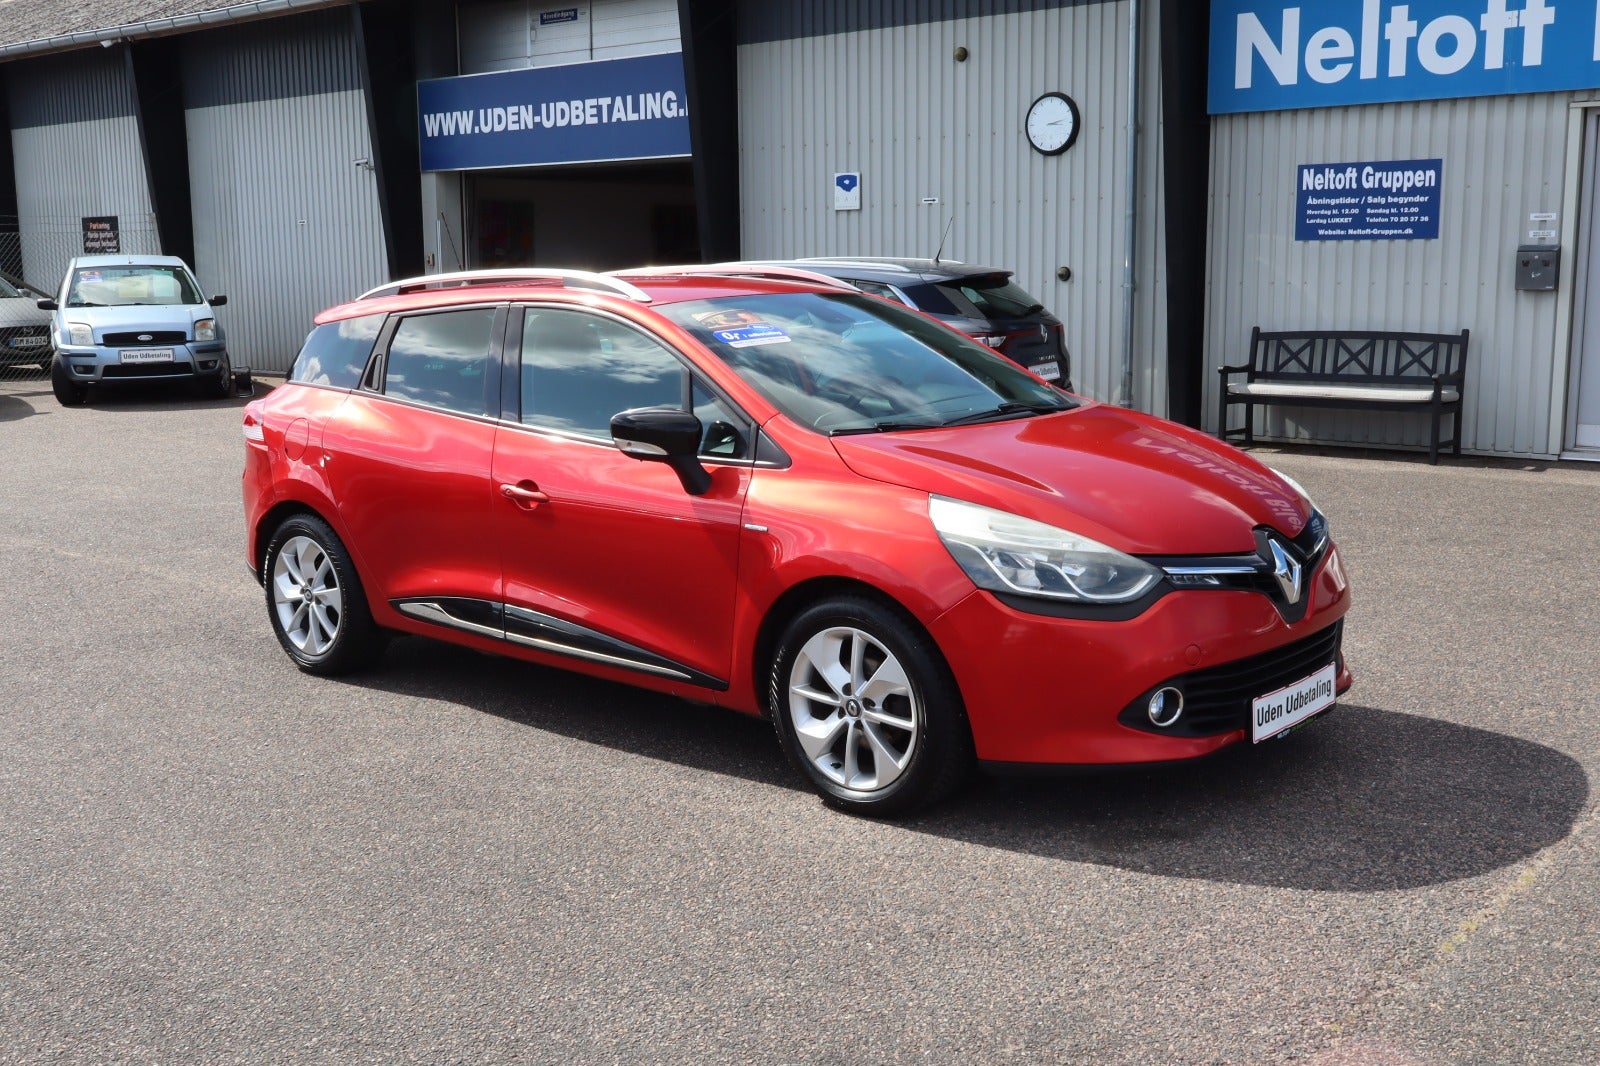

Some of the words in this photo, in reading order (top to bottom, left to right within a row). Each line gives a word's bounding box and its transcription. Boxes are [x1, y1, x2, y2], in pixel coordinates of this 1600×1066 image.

[1234, 0, 1555, 89] Neltoft
[424, 90, 689, 138] WWW.UDEN-UDBETALING.
[1302, 167, 1357, 190] Neltoft
[1362, 166, 1436, 192] Gruppen
[1307, 196, 1360, 206] Åbningstider
[1367, 196, 1386, 205] Salg
[1387, 195, 1430, 204] begynder
[1257, 703, 1283, 727] Uden
[1286, 679, 1331, 715] Udbetaling
